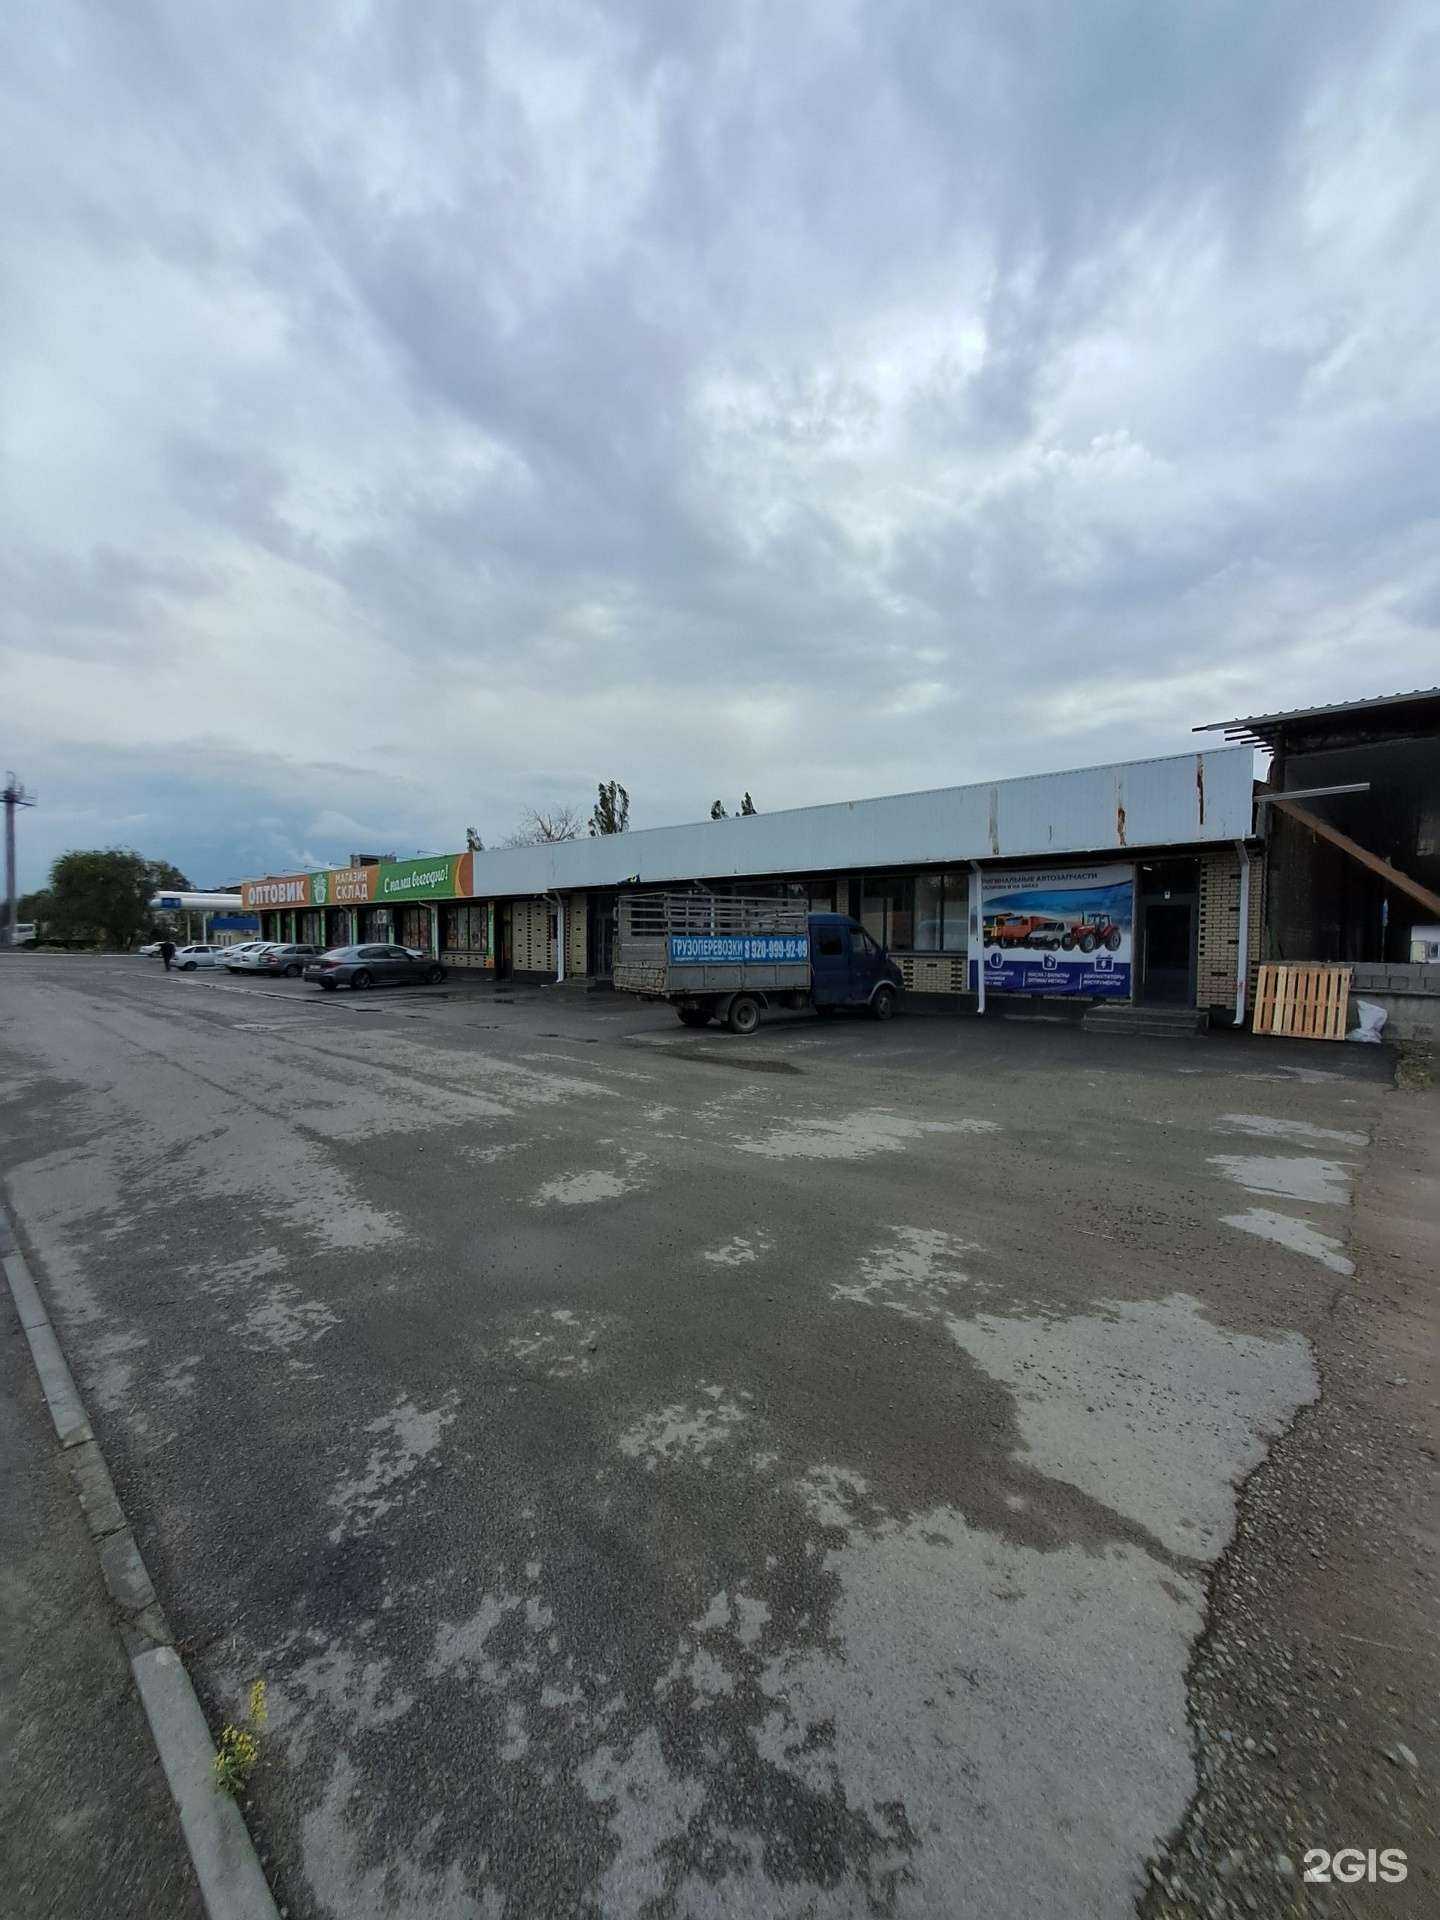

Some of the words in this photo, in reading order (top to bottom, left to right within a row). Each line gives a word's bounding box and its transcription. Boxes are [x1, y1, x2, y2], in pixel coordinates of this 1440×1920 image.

[335, 871, 368, 883] МАГАЗИН
[384, 877, 390, 893] С
[1036, 872, 1098, 882] АВТОЗАПЧАСТИ
[248, 880, 305, 905] ОПТОВИК
[335, 883, 369, 900] СКЛАД
[672, 938, 743, 956] ГРУЗОПЕРЕВОЗКИ
